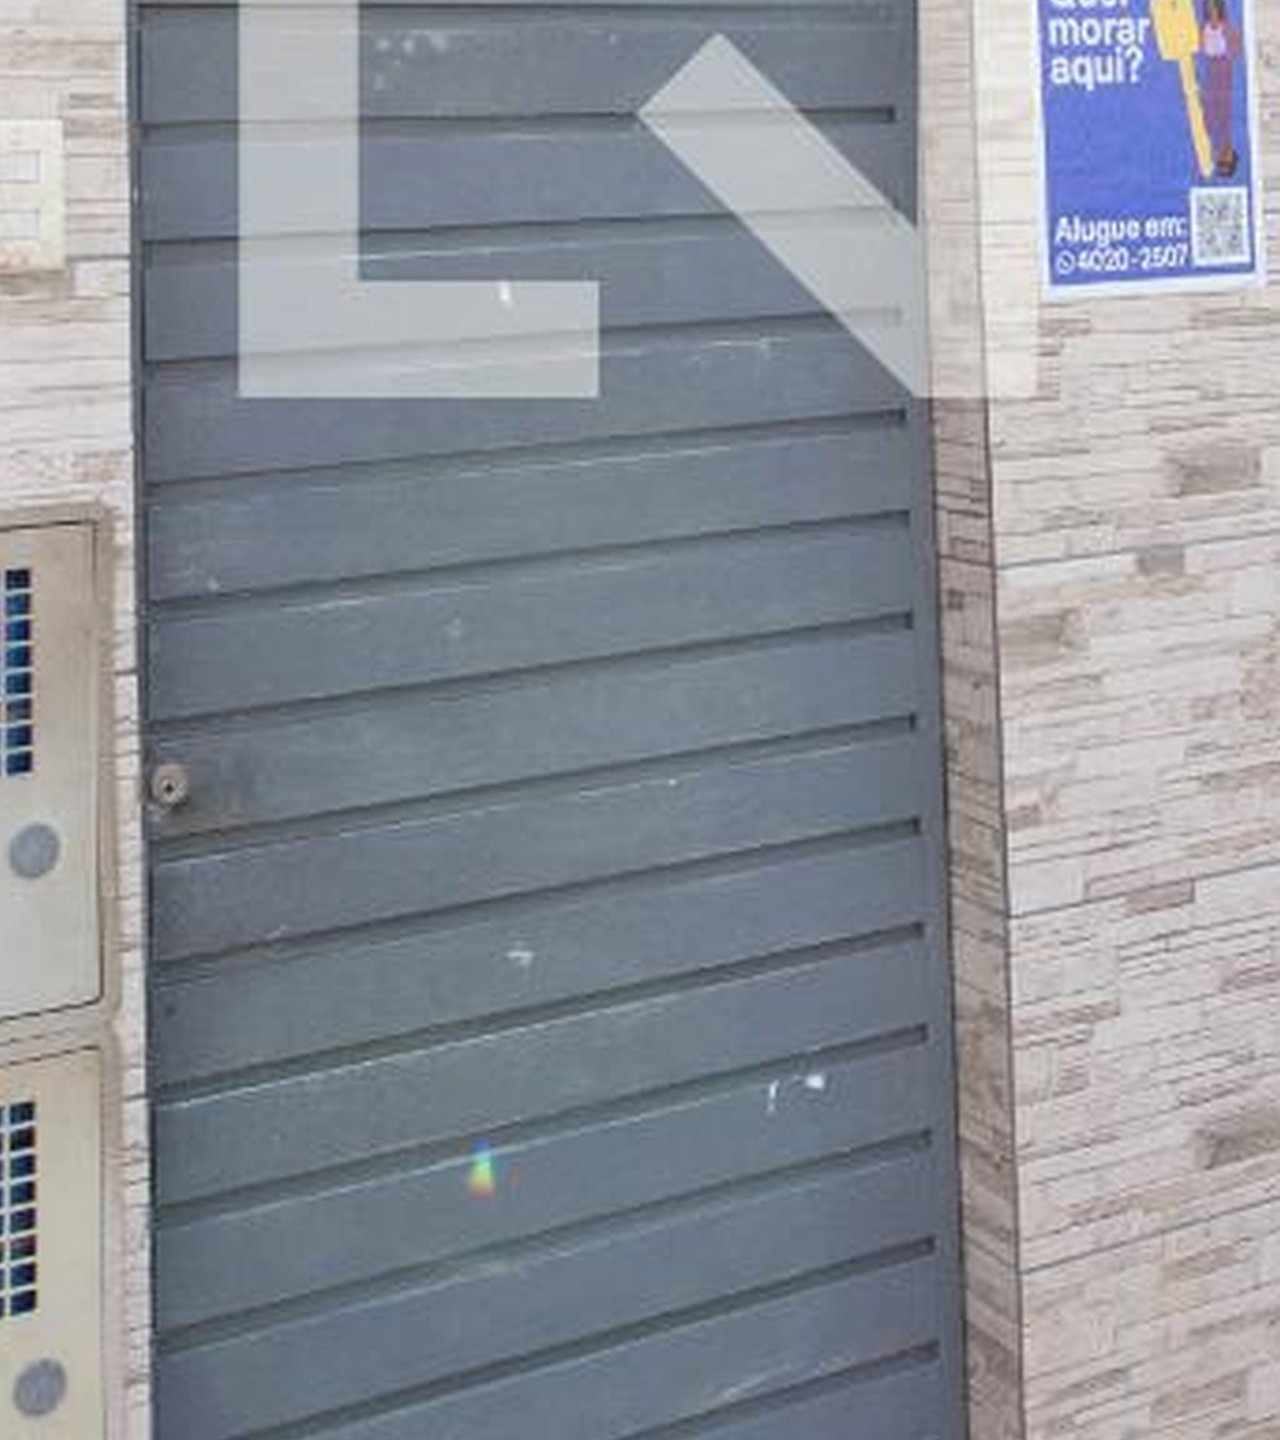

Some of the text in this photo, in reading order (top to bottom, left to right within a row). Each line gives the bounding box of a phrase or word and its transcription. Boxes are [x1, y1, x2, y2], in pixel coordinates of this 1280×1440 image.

[1049, 17, 1151, 46] morar
[1050, 46, 1144, 91] aqui?
[1055, 216, 1142, 246] Alugue
